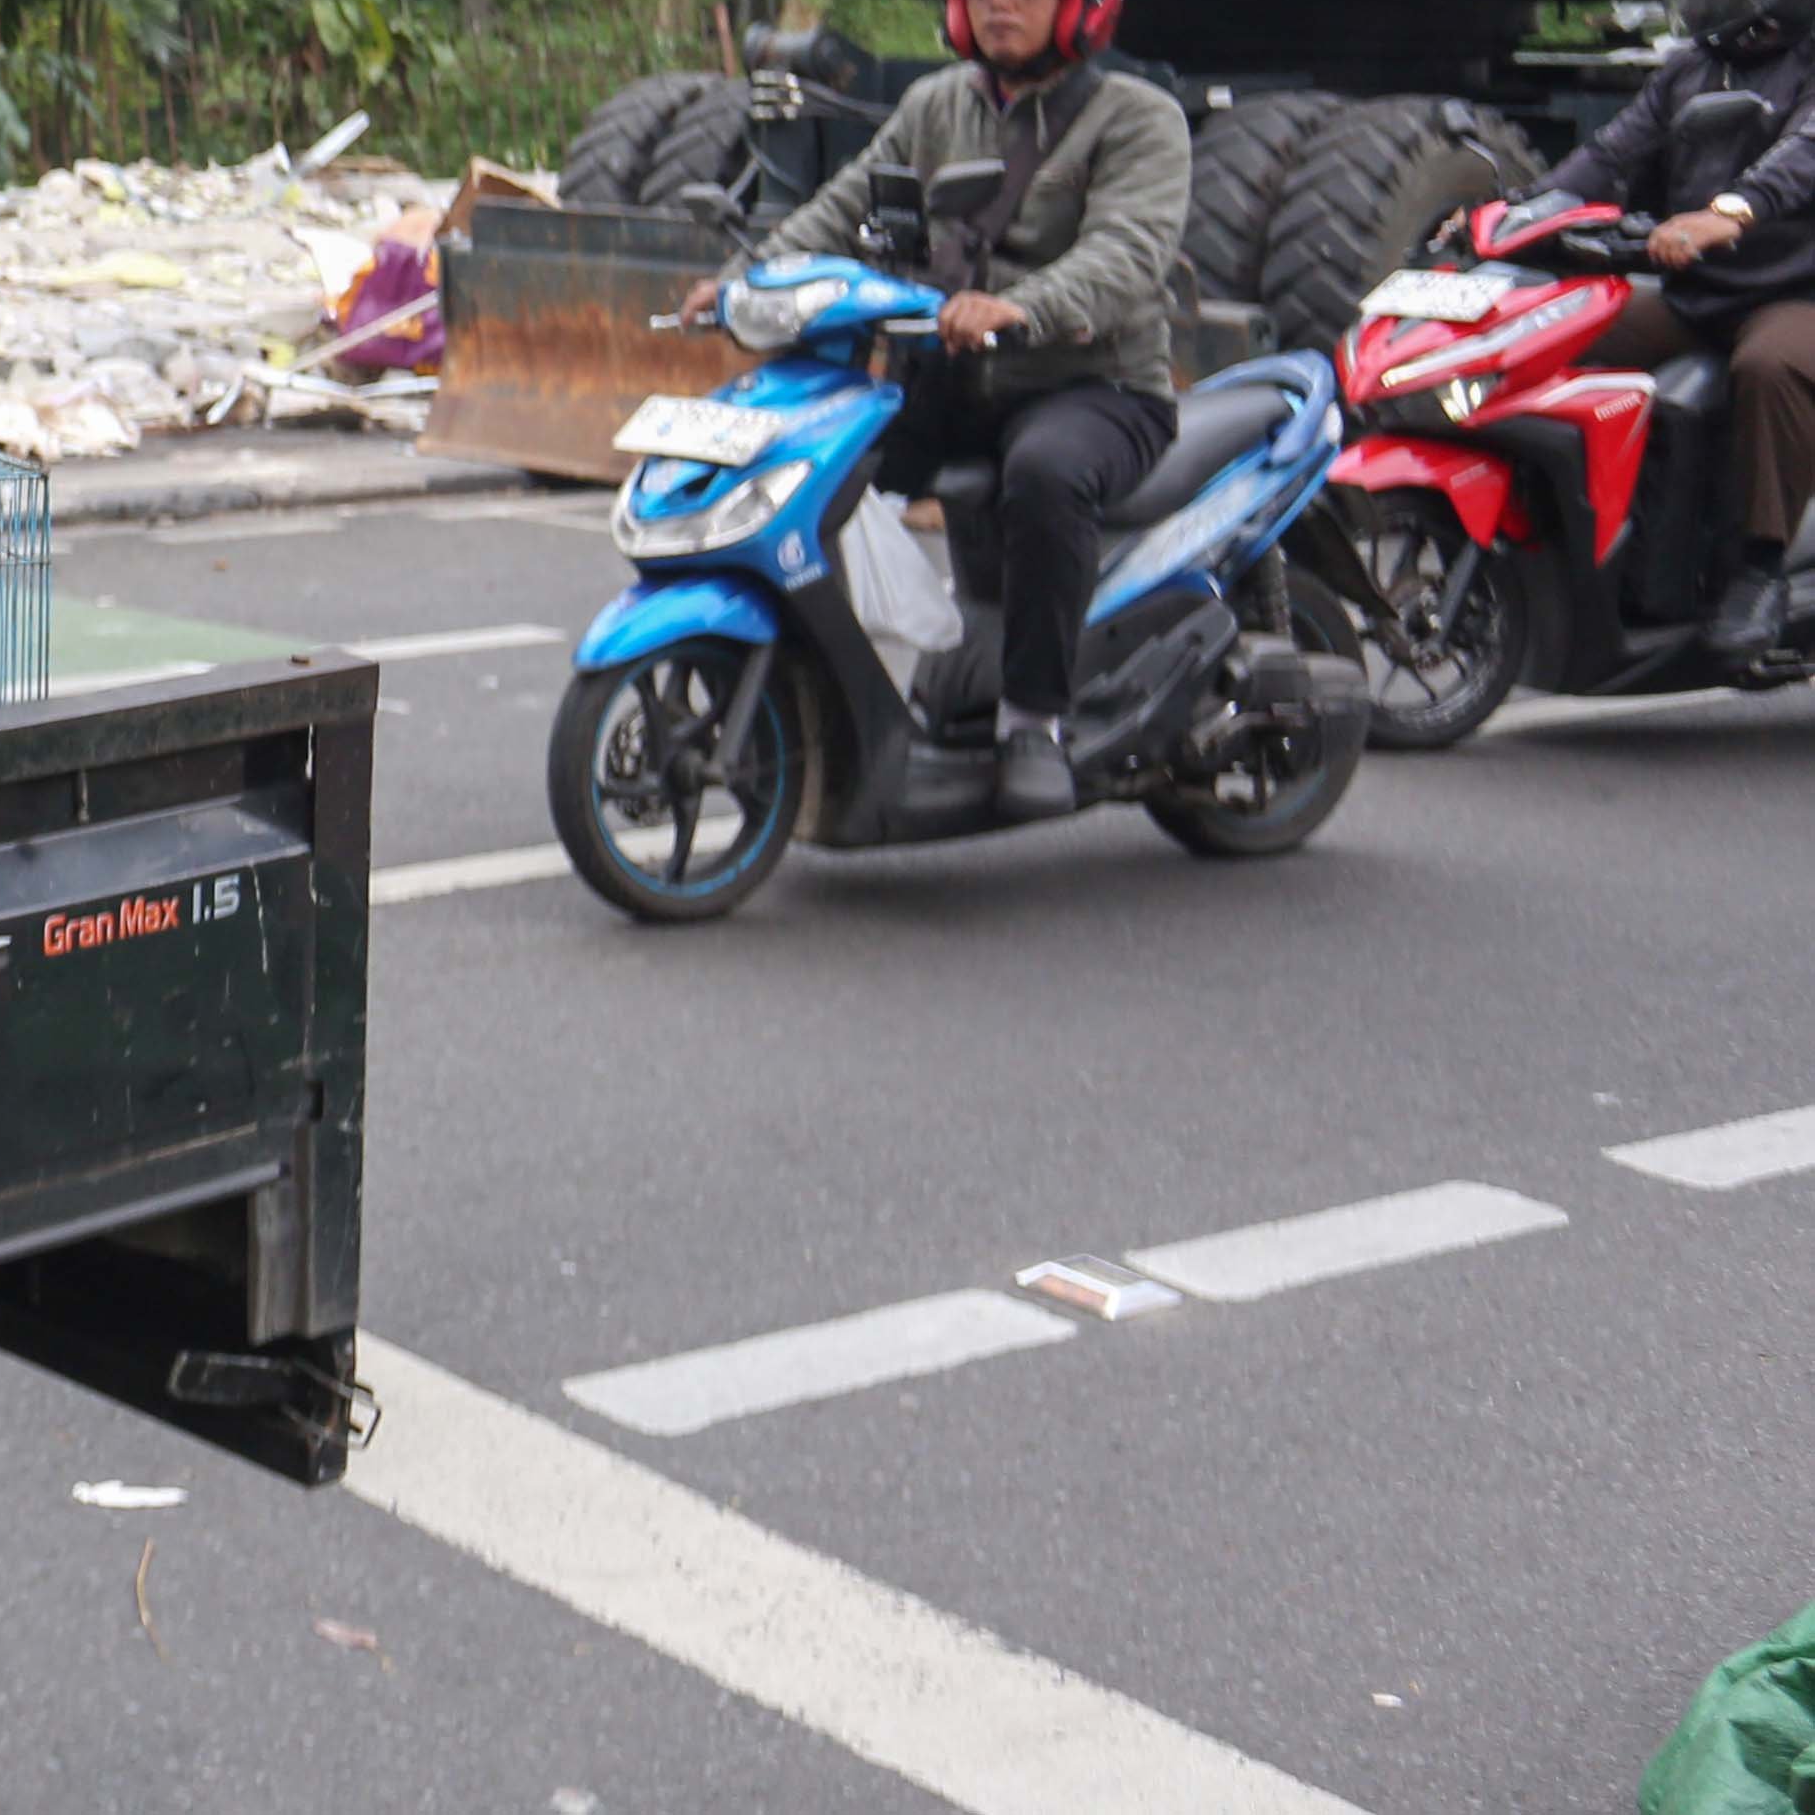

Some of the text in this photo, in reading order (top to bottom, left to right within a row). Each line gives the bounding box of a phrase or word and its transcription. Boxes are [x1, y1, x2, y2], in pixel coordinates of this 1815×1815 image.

[43, 872, 241, 957] Gran Max 1.5
